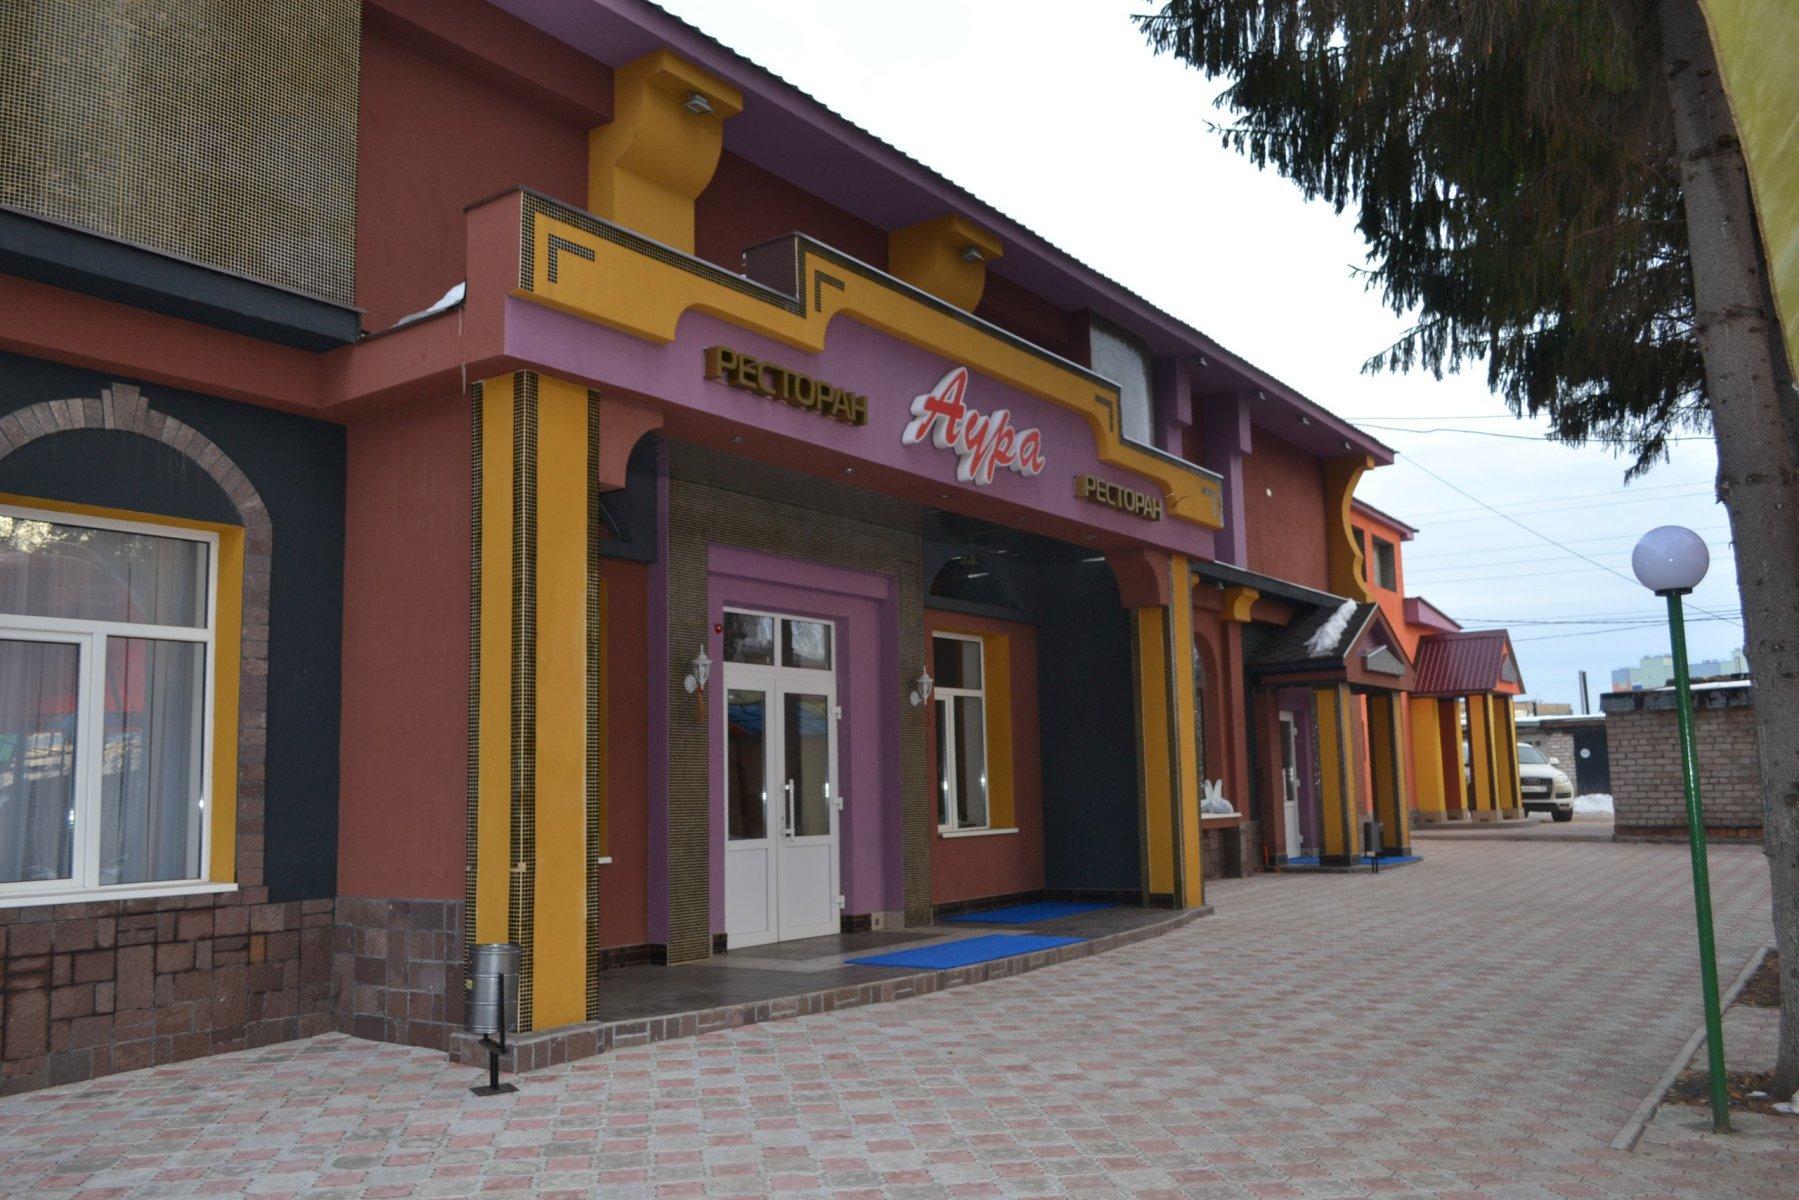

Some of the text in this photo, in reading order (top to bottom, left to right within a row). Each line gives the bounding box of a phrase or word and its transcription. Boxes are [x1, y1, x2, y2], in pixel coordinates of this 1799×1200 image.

[708, 346, 868, 425] РЕСТОРАН
[904, 367, 1045, 485] Аура
[1079, 474, 1163, 520] РЕСТОРАН
